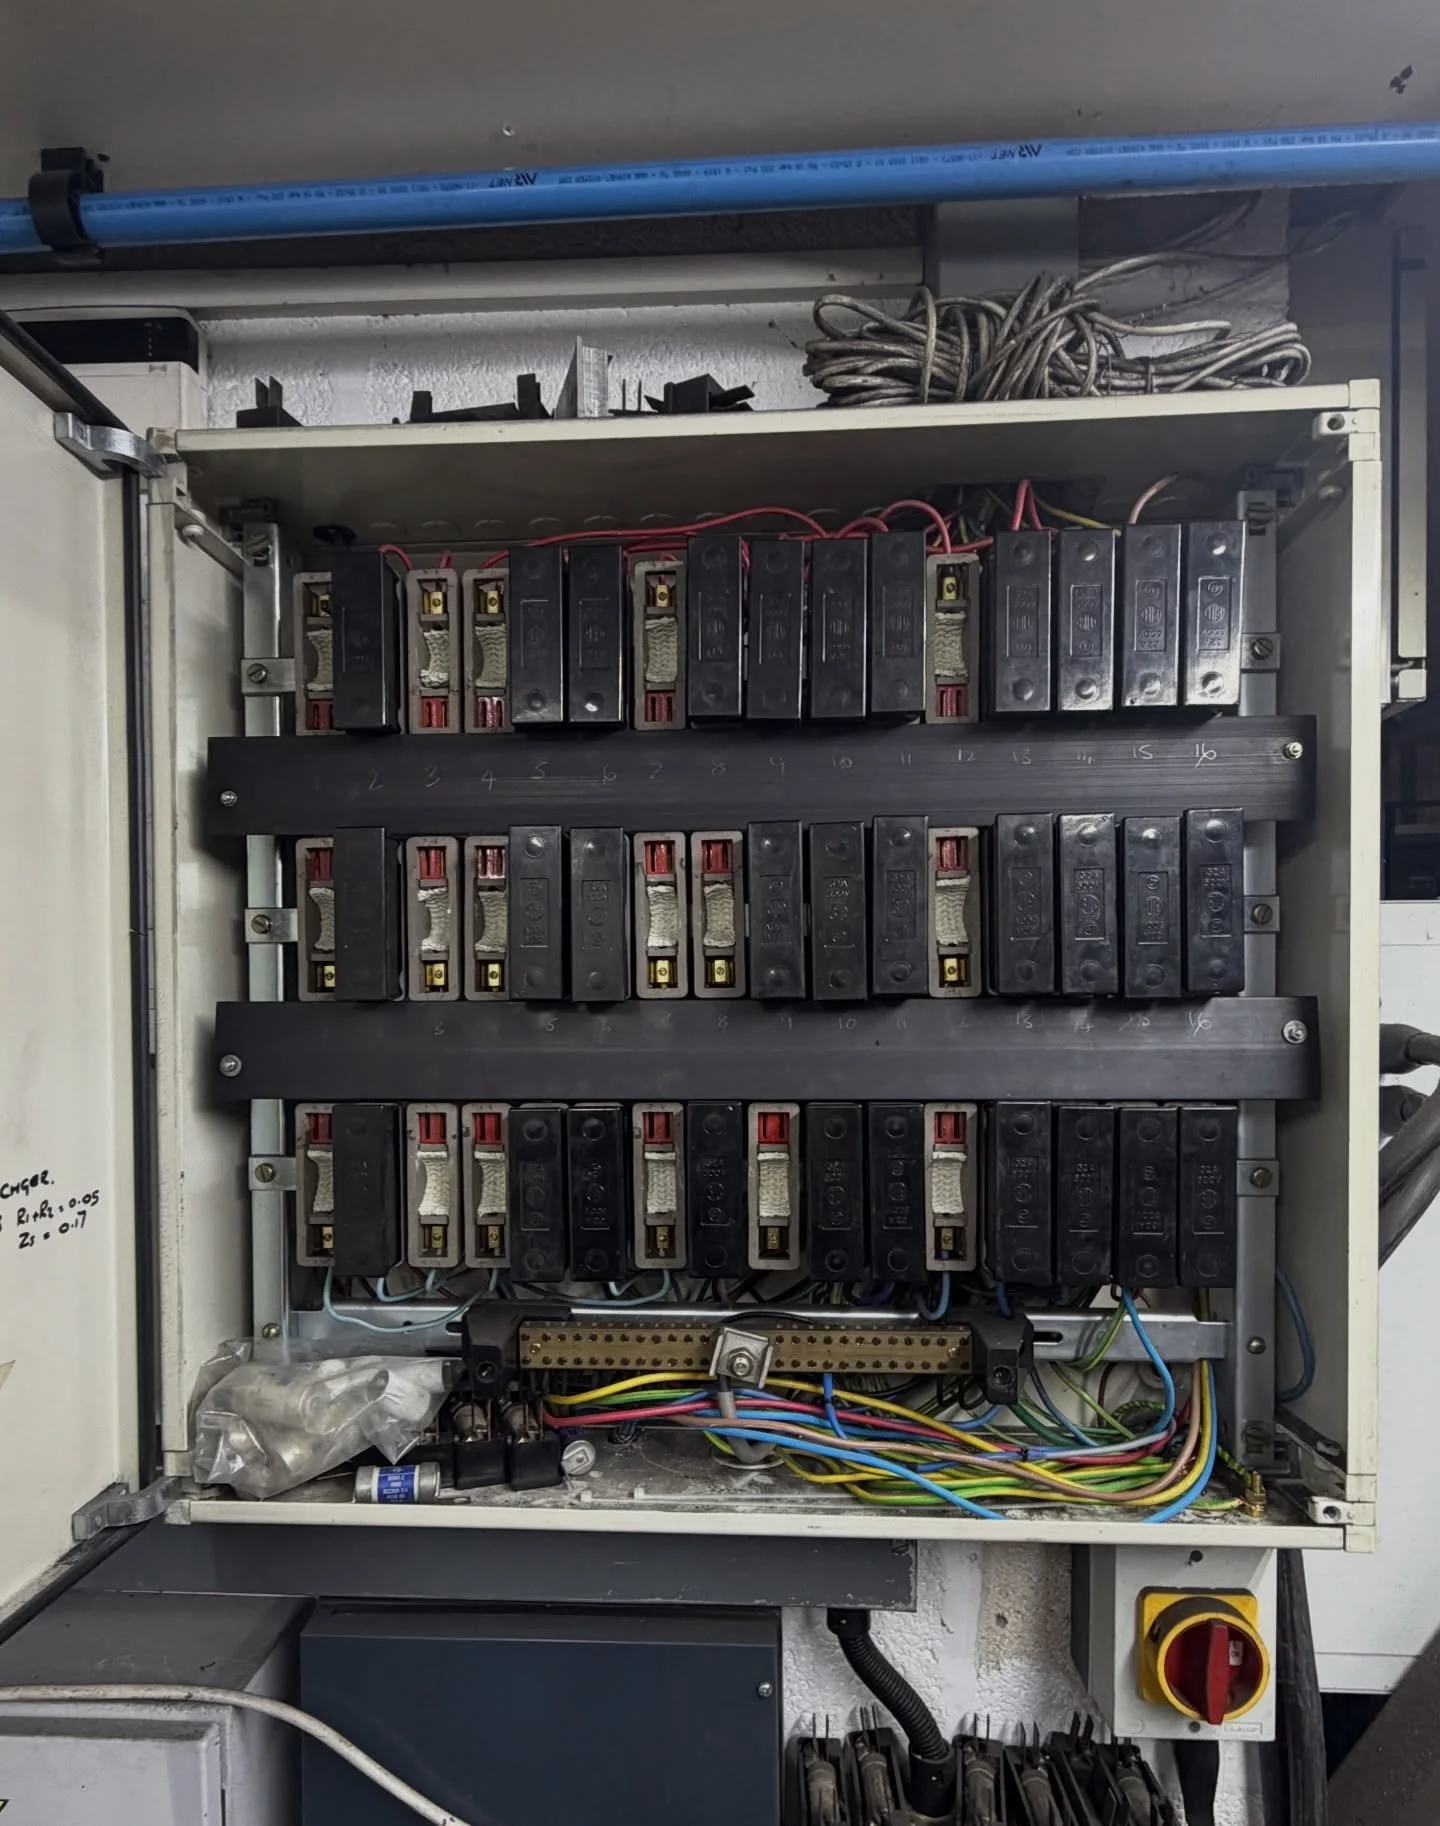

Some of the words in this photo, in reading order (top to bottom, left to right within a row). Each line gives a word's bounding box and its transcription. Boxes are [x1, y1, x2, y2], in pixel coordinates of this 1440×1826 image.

[424, 759, 441, 788] 3
[480, 768, 497, 791] 4
[958, 748, 976, 762] 12
[1132, 745, 1153, 760] 15
[1195, 743, 1217, 768] 16
[68, 1189, 100, 1208] 0.05
[58, 1210, 87, 1234] 0.17
